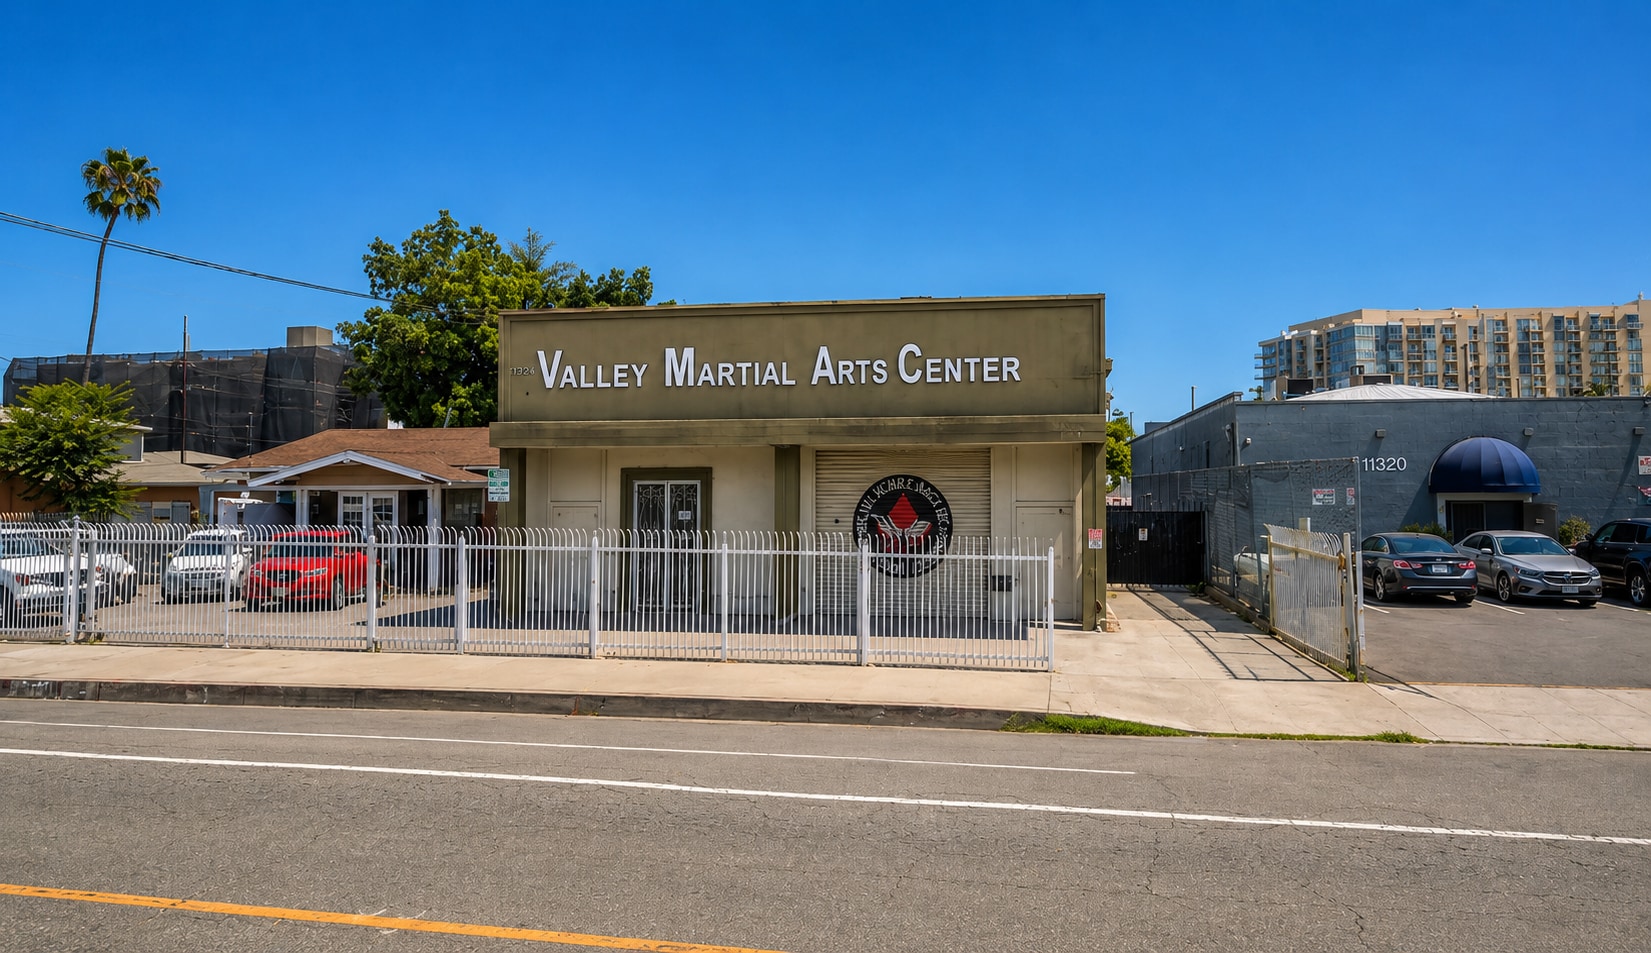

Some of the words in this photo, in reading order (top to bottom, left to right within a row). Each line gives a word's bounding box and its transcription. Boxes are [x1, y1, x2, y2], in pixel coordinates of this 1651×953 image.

[536, 349, 648, 389] VALLEY
[664, 346, 797, 387] MARTIAL
[810, 345, 889, 386] ARTS
[897, 342, 1022, 384] CENTER
[1361, 456, 1408, 472] 11320
